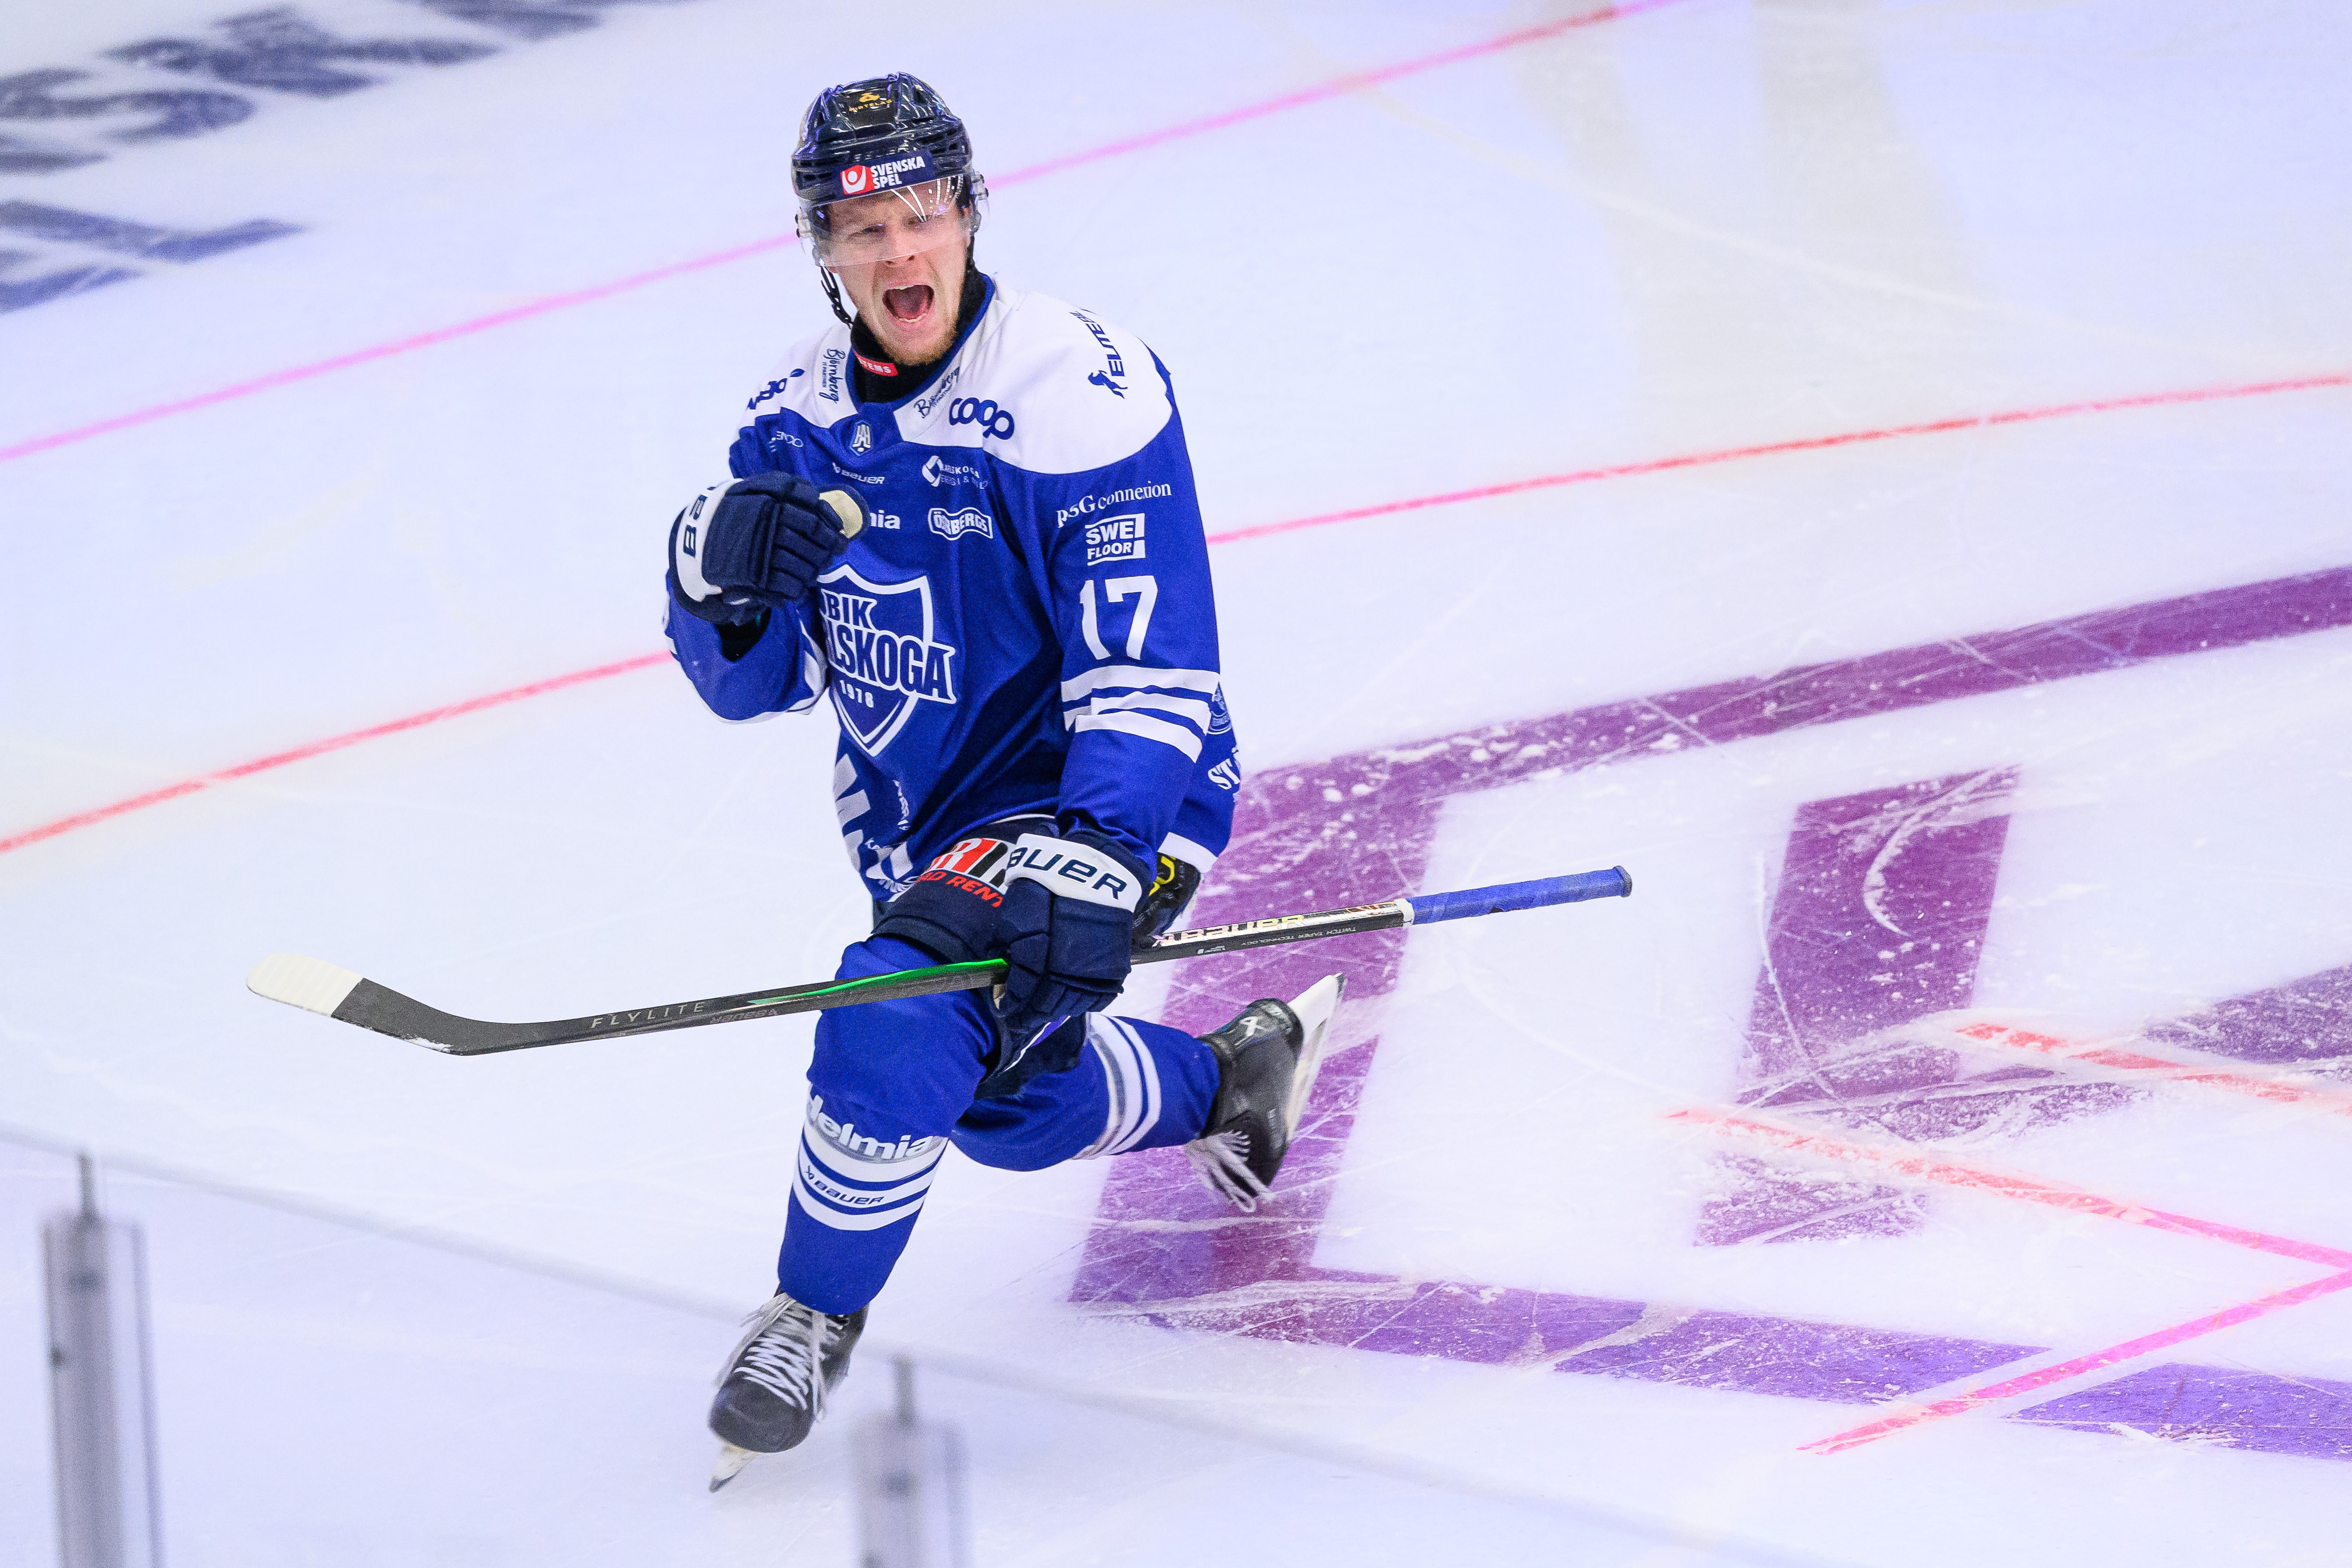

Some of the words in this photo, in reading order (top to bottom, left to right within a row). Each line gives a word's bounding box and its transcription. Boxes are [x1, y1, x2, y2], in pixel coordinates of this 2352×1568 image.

[870, 156, 925, 178] SVENSKA
[874, 173, 902, 189] SPEL
[819, 348, 846, 404] Björnberg
[949, 398, 1014, 440] coop
[1085, 521, 1134, 545] SWE
[1087, 542, 1132, 560] FLOOR
[1079, 575, 1158, 660] 17
[590, 1002, 705, 1029] FLYLITE
[814, 1180, 885, 1205] BAUER
